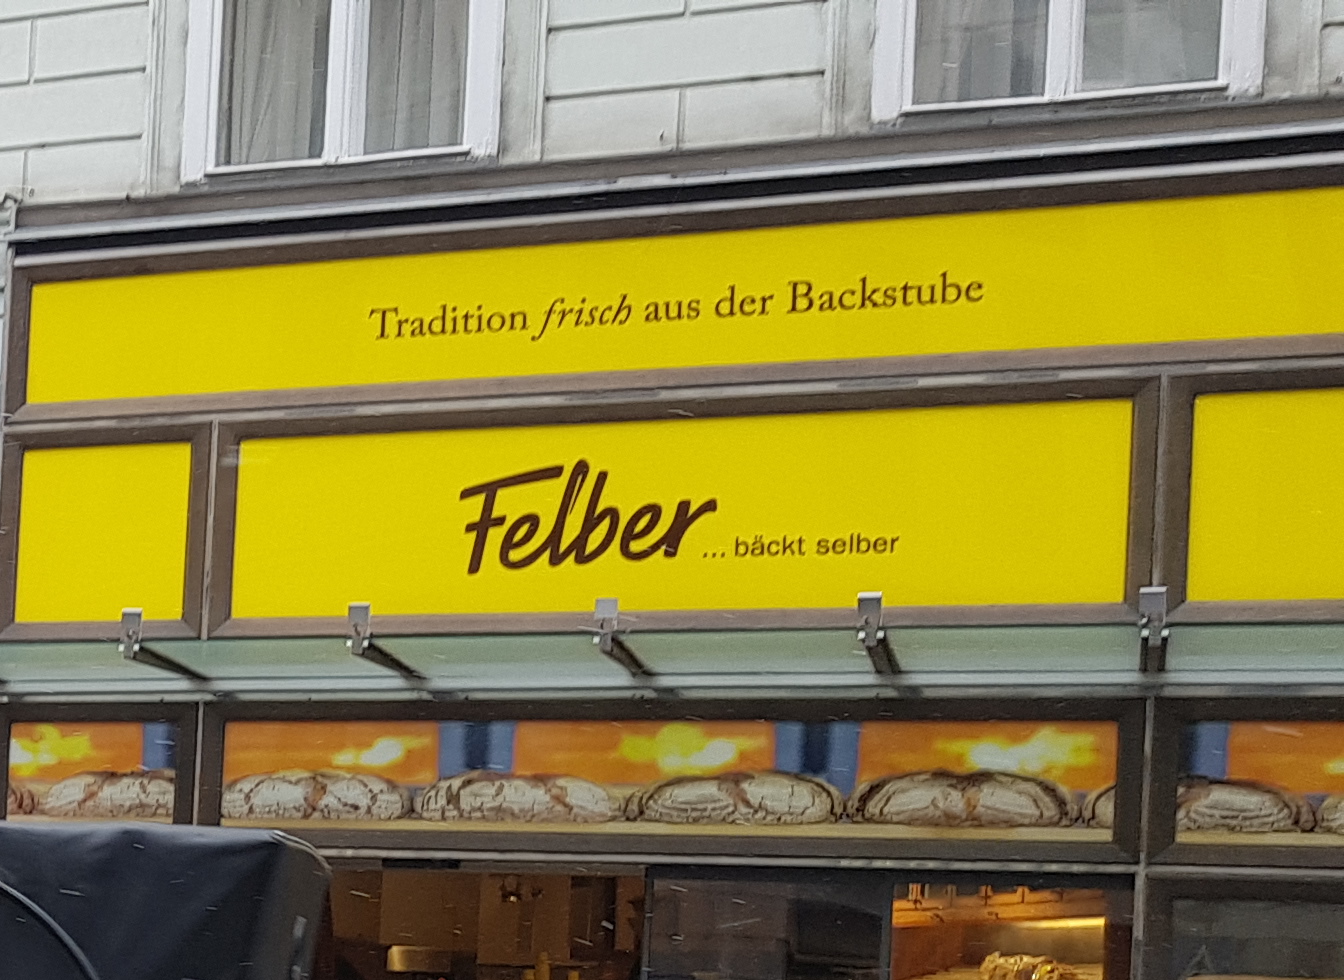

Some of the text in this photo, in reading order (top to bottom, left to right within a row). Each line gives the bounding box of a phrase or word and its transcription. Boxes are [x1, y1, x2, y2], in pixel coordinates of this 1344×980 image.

[368, 270, 985, 342] Tradition frisch aus der Backstube
[459, 458, 718, 576] Felber
[734, 534, 807, 558] bäckt
[815, 532, 901, 556] selber
